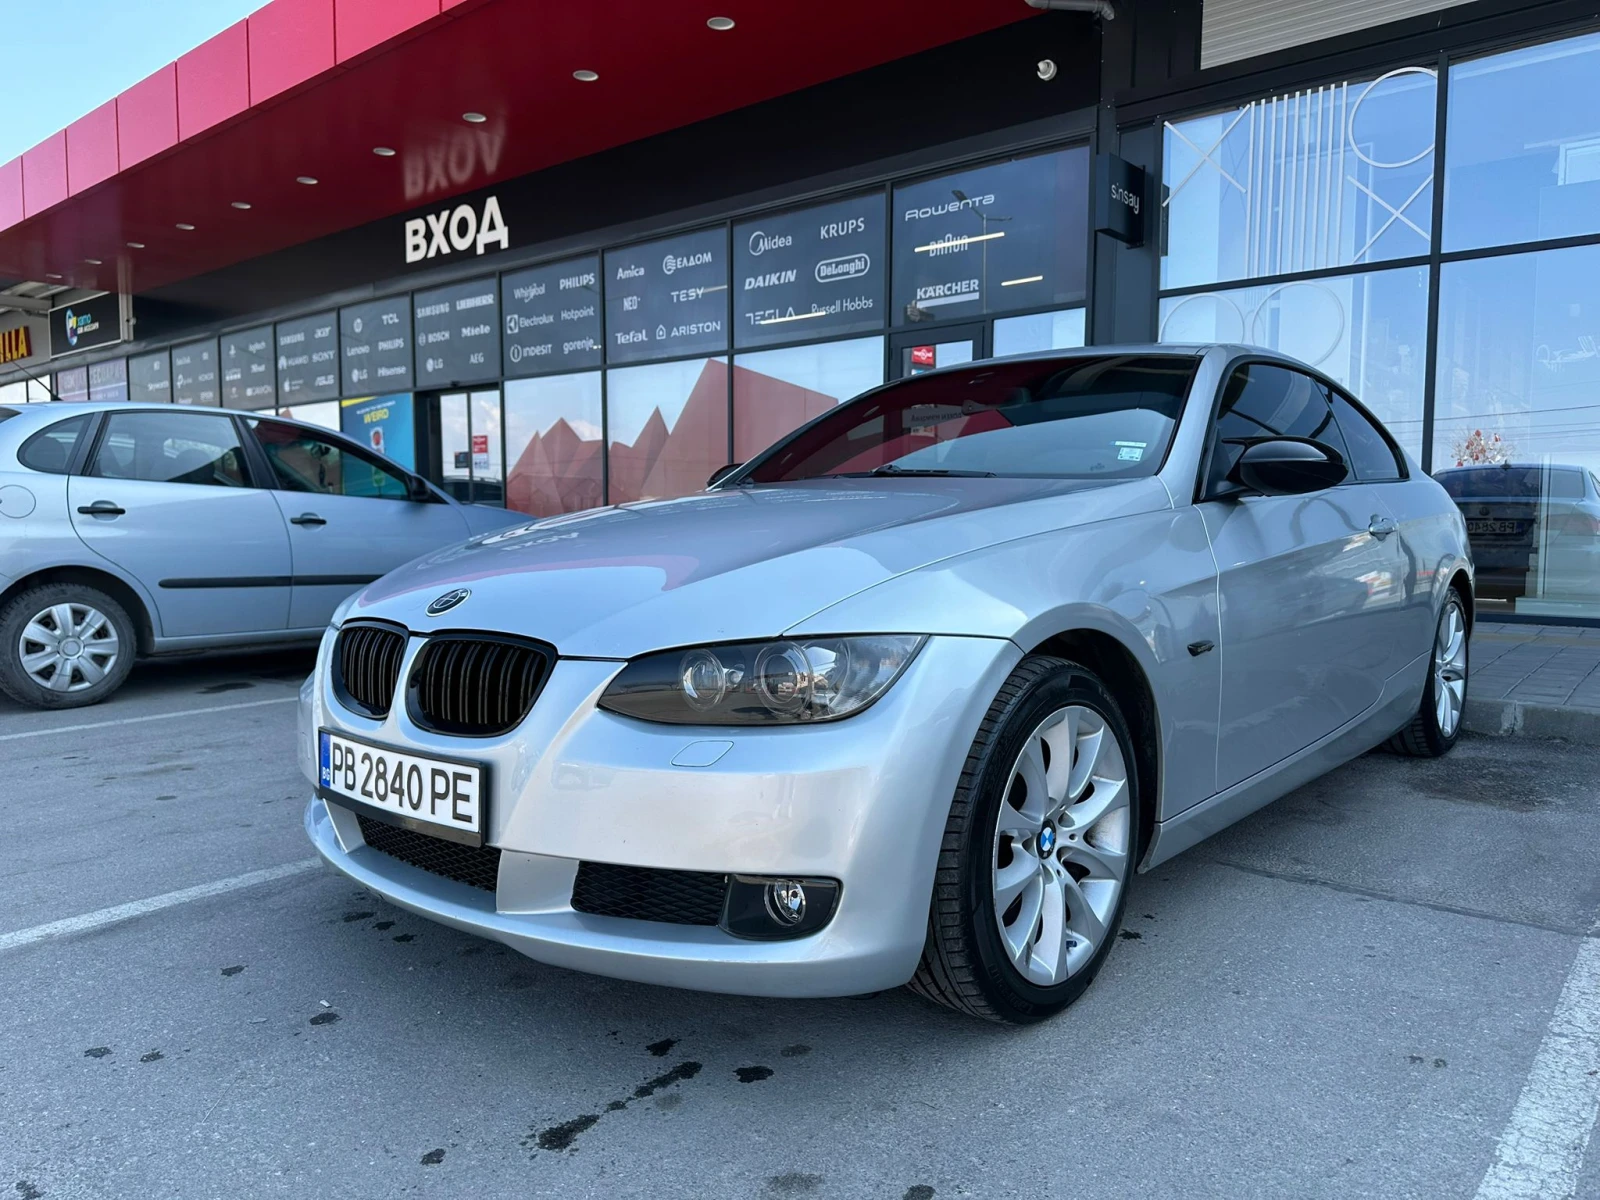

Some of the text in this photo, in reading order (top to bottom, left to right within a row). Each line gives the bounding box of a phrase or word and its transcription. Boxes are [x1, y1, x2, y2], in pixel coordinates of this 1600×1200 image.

[1111, 182, 1139, 215] sinsay
[405, 195, 509, 263] ВХОД
[820, 217, 865, 239] KRUPS
[750, 231, 792, 256] Midea
[616, 265, 645, 280] Amica
[744, 269, 797, 290] DAIKIN
[559, 272, 595, 290] PHILIPS
[916, 279, 979, 299] KÄRCHER
[513, 283, 546, 303] Whirlpool
[670, 286, 705, 303] TESY
[416, 302, 450, 318] SAMSUNG
[456, 293, 494, 311] LIEBHERR
[811, 296, 873, 315] Russell Hobbs
[381, 313, 399, 325] TCL
[519, 313, 554, 328] Electrolux
[560, 305, 595, 321] Hotpoint
[745, 306, 796, 325] TESLA
[428, 331, 450, 343] BOSCH
[460, 324, 491, 338] Miele
[615, 329, 648, 344] Tefal
[670, 321, 721, 337] ARISTON
[346, 345, 370, 356] Lenovo
[378, 338, 404, 351] PHILIPS
[563, 336, 594, 354] gorenje
[312, 350, 336, 362] SONY
[434, 358, 444, 369] LG
[469, 353, 484, 364] AEG
[359, 369, 368, 380] LG
[377, 365, 407, 377] Hisense
[321, 765, 331, 781] BG
[332, 742, 473, 824] PB 2840 PE
